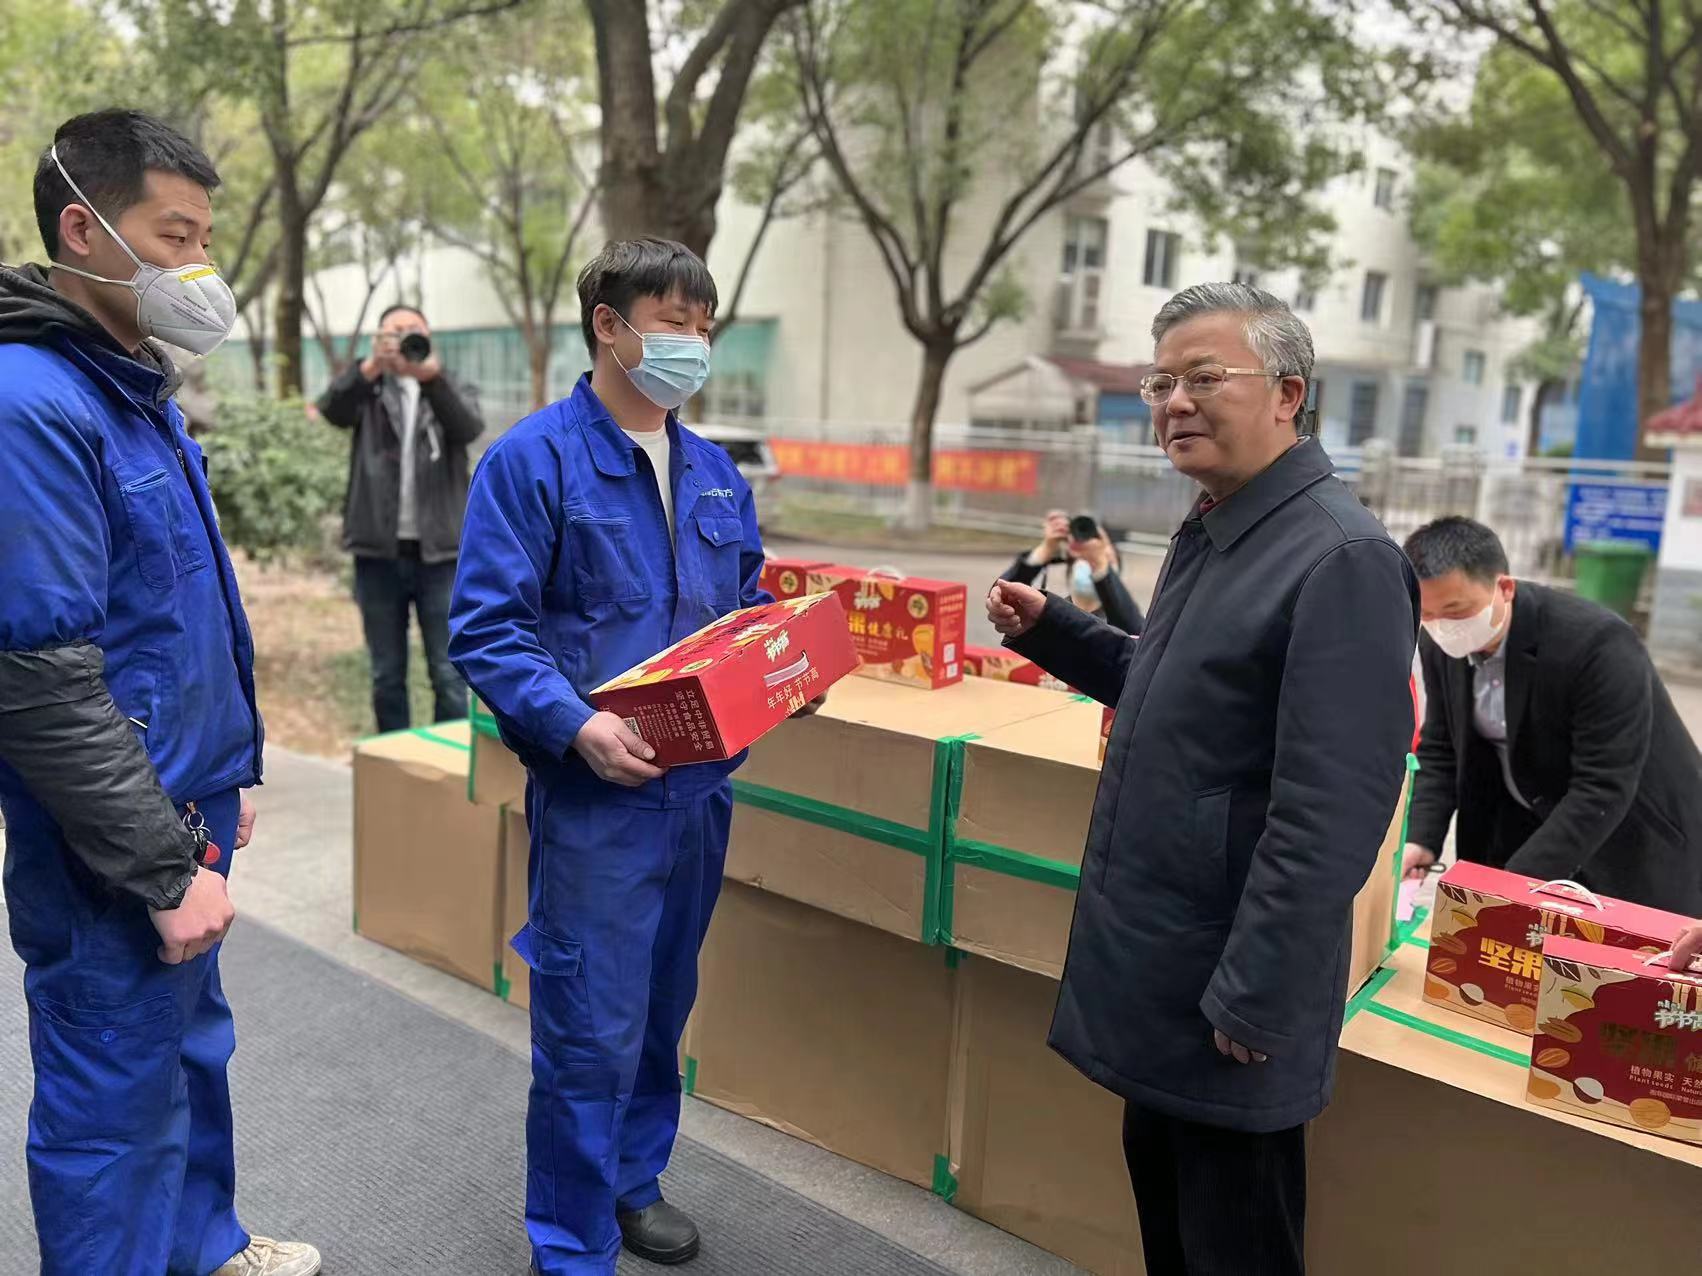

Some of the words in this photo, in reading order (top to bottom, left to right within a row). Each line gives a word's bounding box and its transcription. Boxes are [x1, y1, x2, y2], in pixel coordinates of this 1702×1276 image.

[767, 684, 793, 709] 年年好
[793, 666, 820, 691] 节节高
[675, 690, 704, 752] 坚守食品安全
[685, 689, 715, 751] 立足中非贸易
[1478, 937, 1544, 981] 坚果
[1629, 1074, 1650, 1086] Plant
[1630, 1065, 1676, 1083] 植物果实
